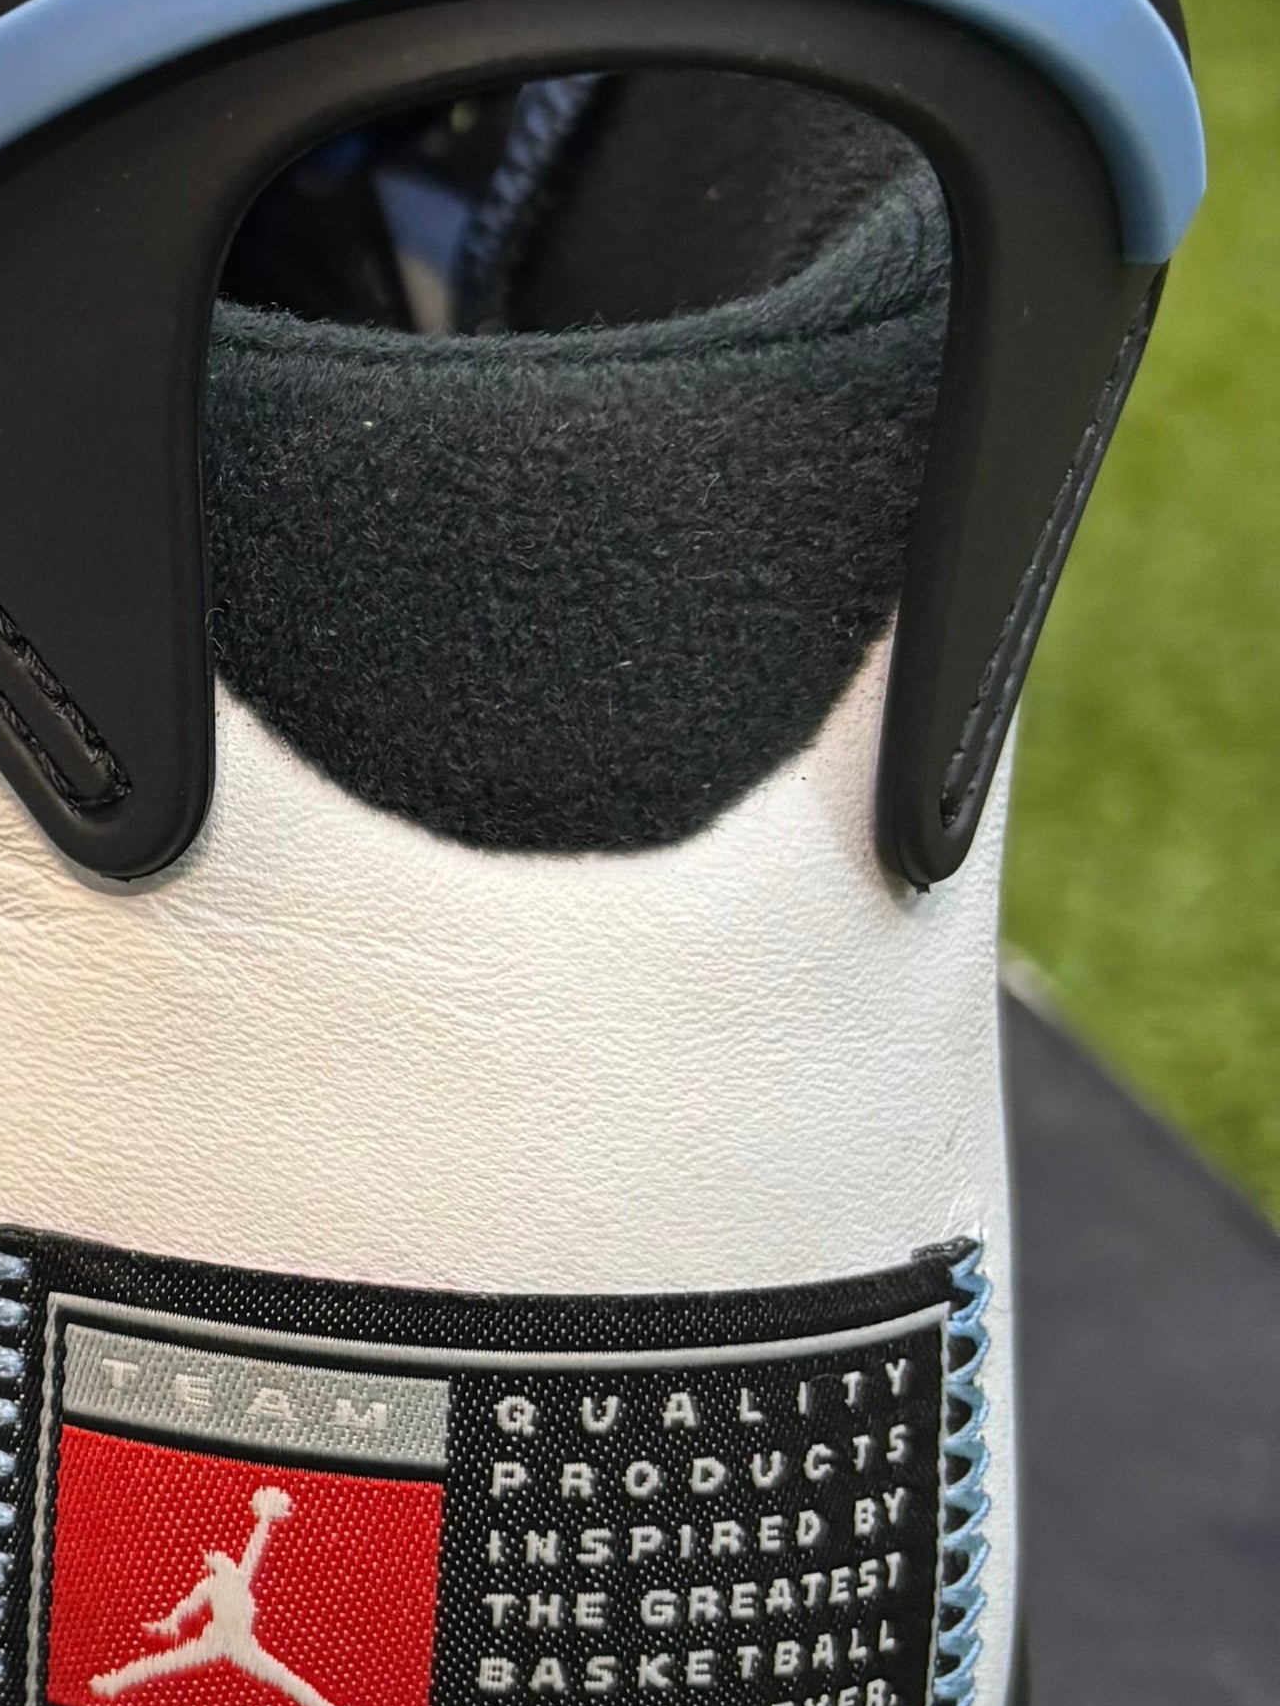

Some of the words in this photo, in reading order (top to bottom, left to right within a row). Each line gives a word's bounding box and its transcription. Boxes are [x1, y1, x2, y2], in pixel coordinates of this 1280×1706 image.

[101, 1358, 388, 1431] TEAM
[493, 1358, 909, 1437] QUALITY
[490, 1423, 910, 1499] PRODUCTS
[485, 1508, 823, 1566] INSPIRED
[853, 1486, 907, 1537] BY
[482, 1592, 609, 1630] THE
[639, 1551, 904, 1629] GREATEST
[477, 1619, 897, 1693] BASKETBALL
